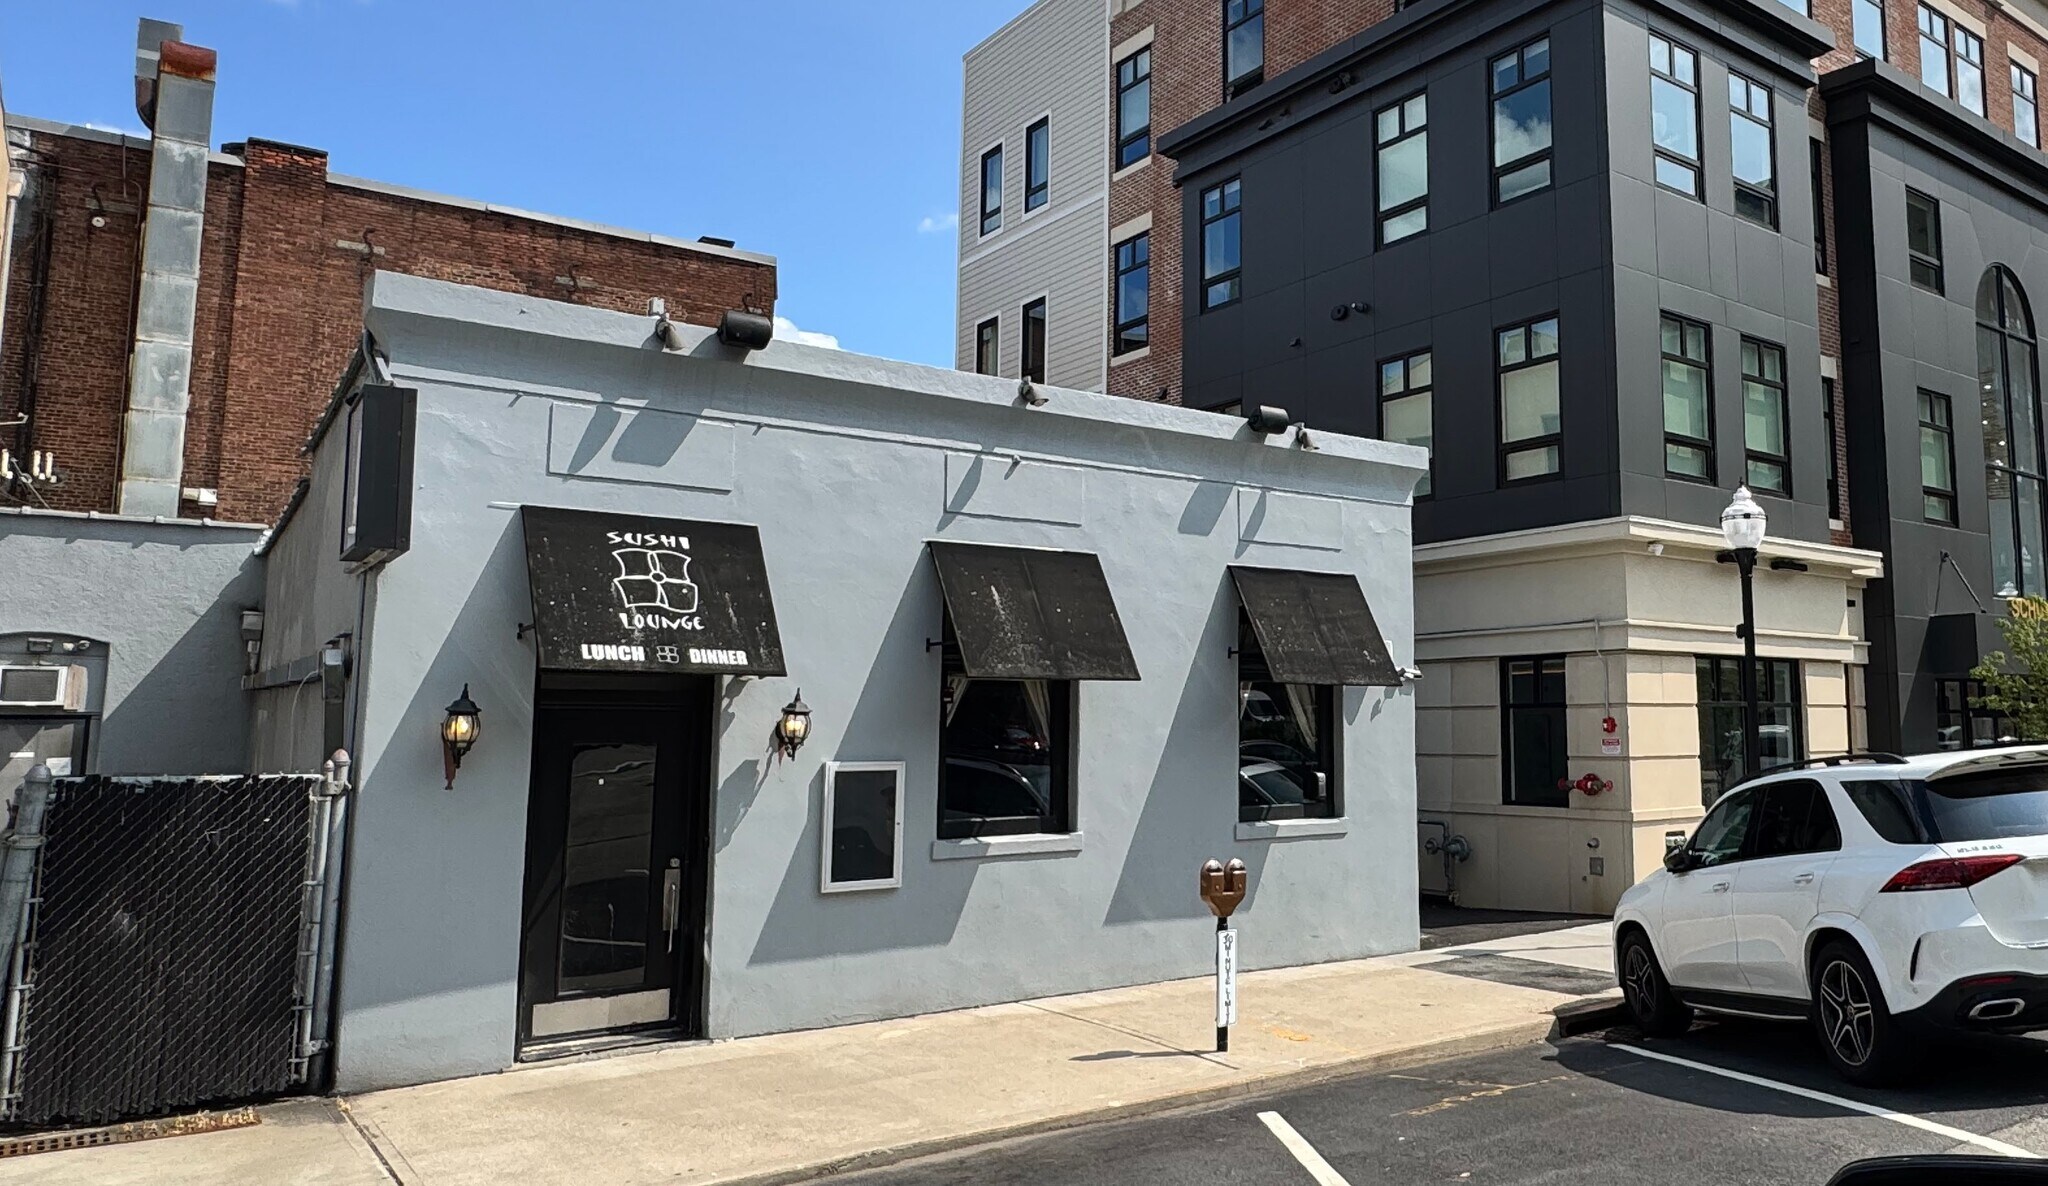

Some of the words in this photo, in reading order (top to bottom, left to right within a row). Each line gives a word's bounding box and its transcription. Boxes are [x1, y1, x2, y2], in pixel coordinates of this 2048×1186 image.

[606, 531, 690, 550] SUSHI
[619, 612, 705, 630] LOUNGE
[581, 643, 646, 662] LUNCH
[689, 648, 749, 666] DINNER
